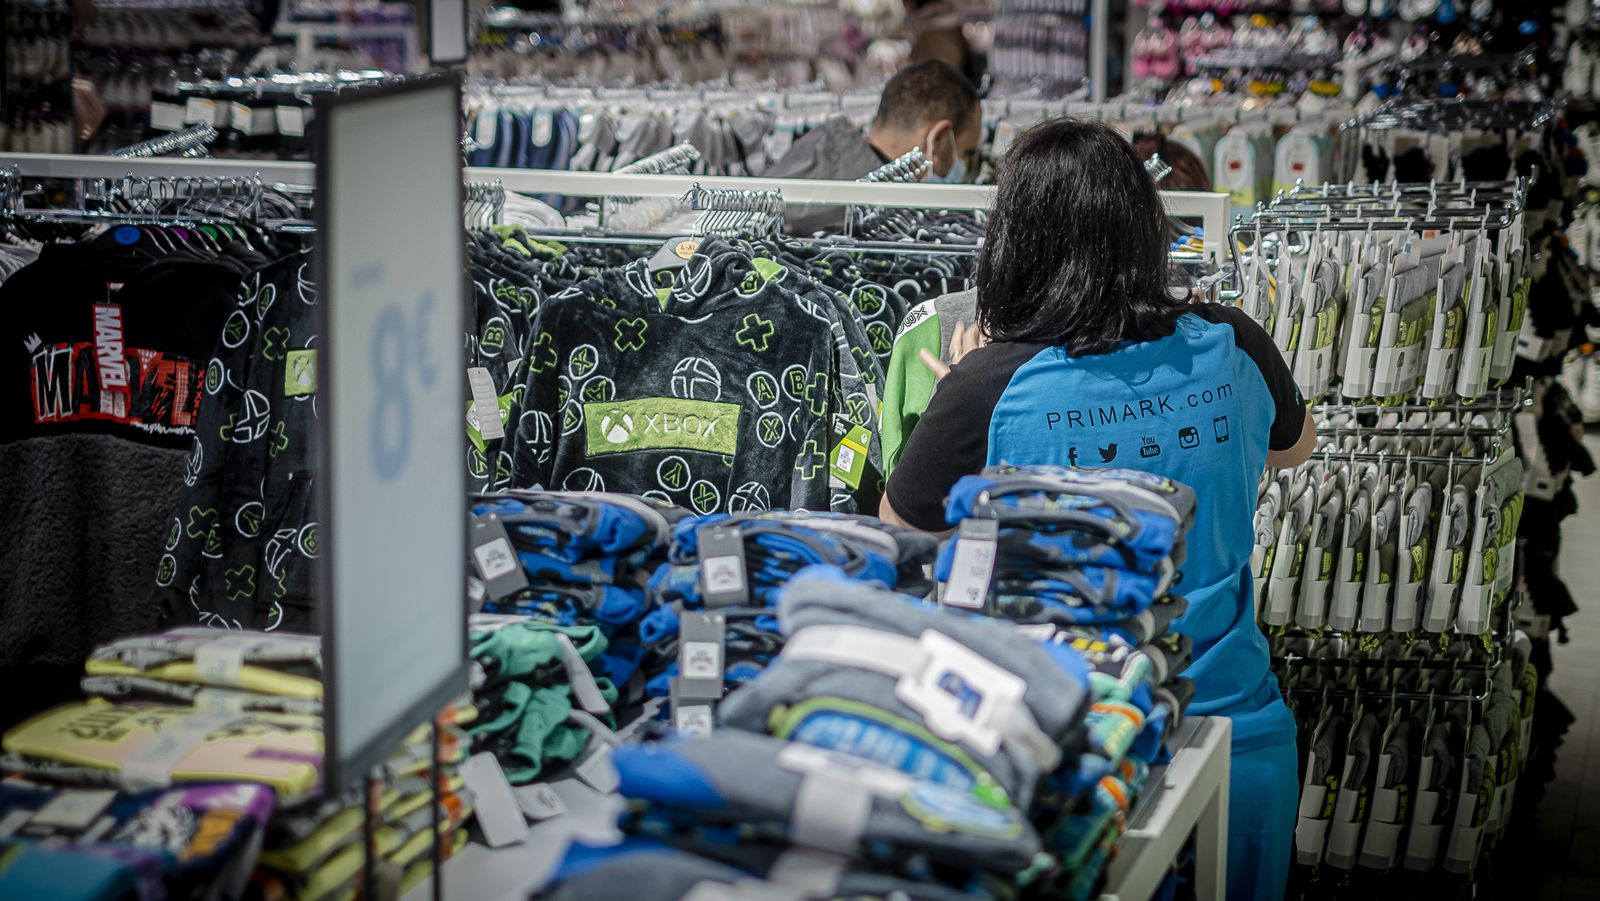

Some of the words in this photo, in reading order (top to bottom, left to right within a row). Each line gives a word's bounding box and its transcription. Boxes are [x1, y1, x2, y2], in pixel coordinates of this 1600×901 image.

[94, 305, 128, 390] MARVEL
[32, 346, 193, 426] MAVEL
[1046, 383, 1233, 430] PRIMARK.com
[643, 412, 721, 439] XBOX
[1140, 435, 1156, 445] You
[1142, 445, 1159, 457] Tube
